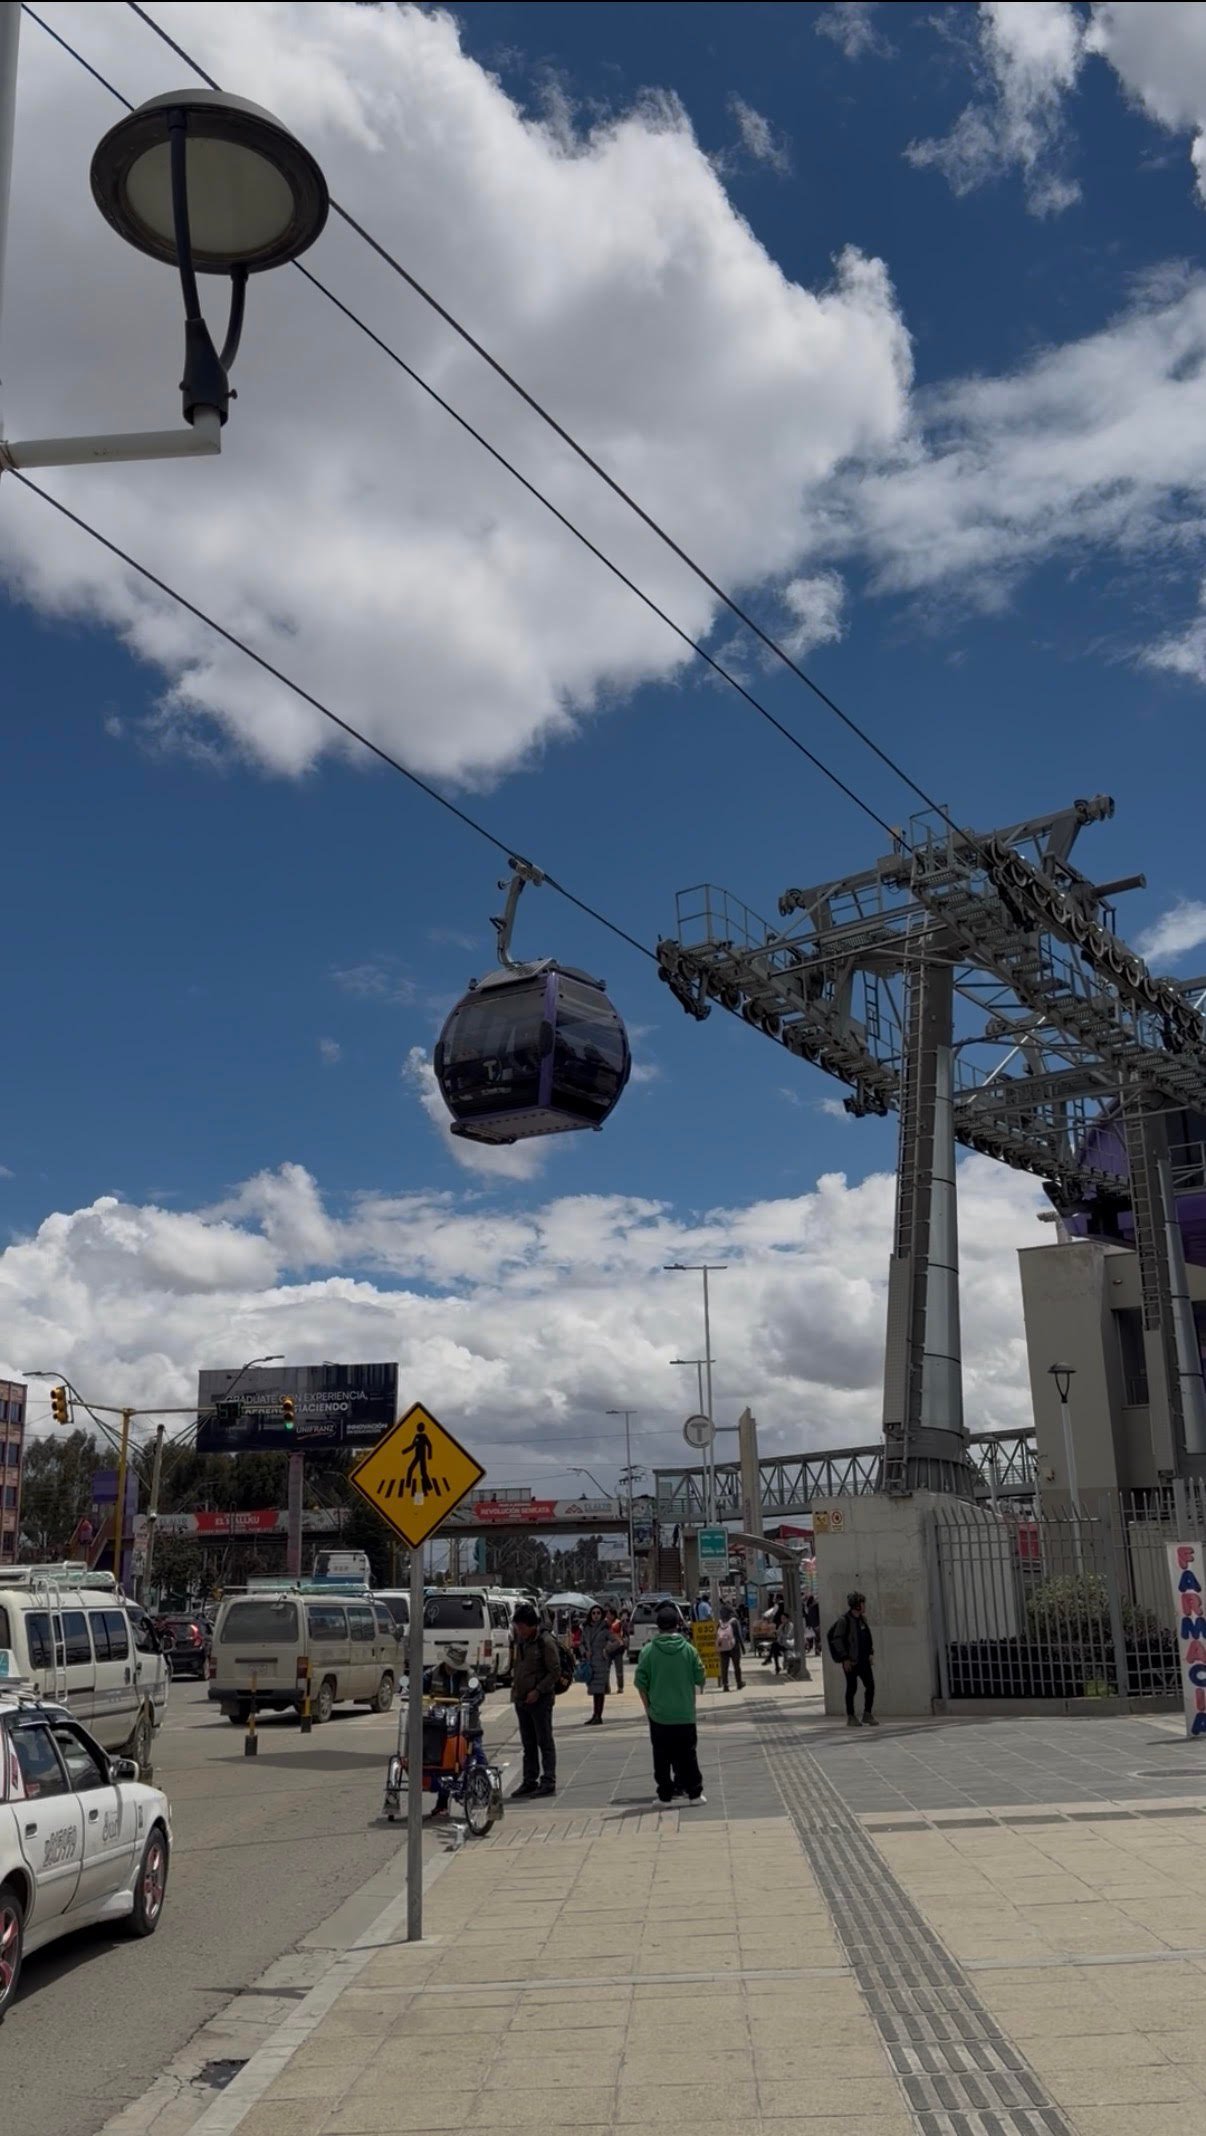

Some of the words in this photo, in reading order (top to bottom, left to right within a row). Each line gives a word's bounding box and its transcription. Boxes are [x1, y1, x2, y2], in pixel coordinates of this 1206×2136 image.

[279, 1393, 302, 1402] CN
[296, 1424, 334, 1433] UNIFRANZ
[1176, 1546, 1206, 1735] FARMACIA
